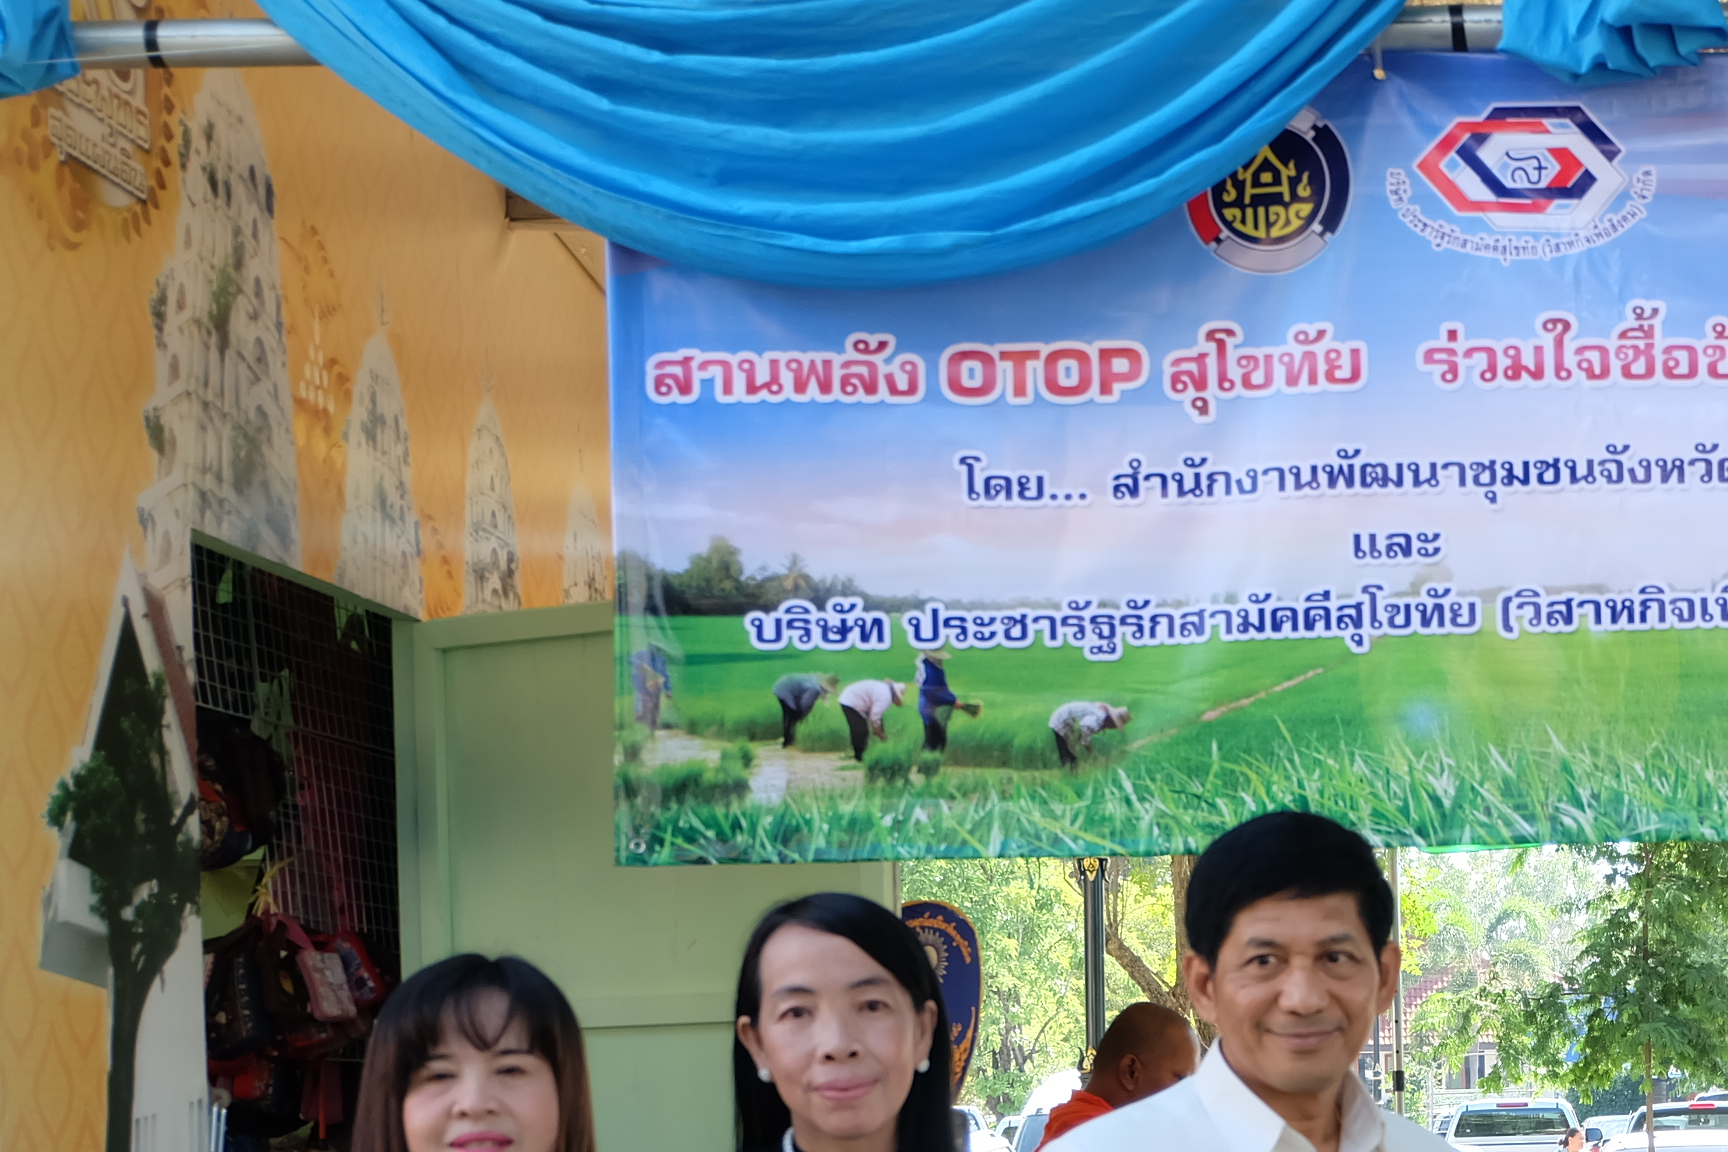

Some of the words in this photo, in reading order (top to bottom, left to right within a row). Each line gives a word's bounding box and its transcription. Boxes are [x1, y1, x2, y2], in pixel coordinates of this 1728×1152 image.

[651, 336, 922, 400] สานพลัง
[944, 346, 1145, 400] OTOP
[1167, 326, 1364, 418] สุโขทัย
[957, 454, 1089, 502] โดย...
[1352, 530, 1442, 560] และ
[749, 600, 885, 645] บริษัท
[907, 583, 1477, 656] ประชารัฐรักสามัคคีสุโขทัย
